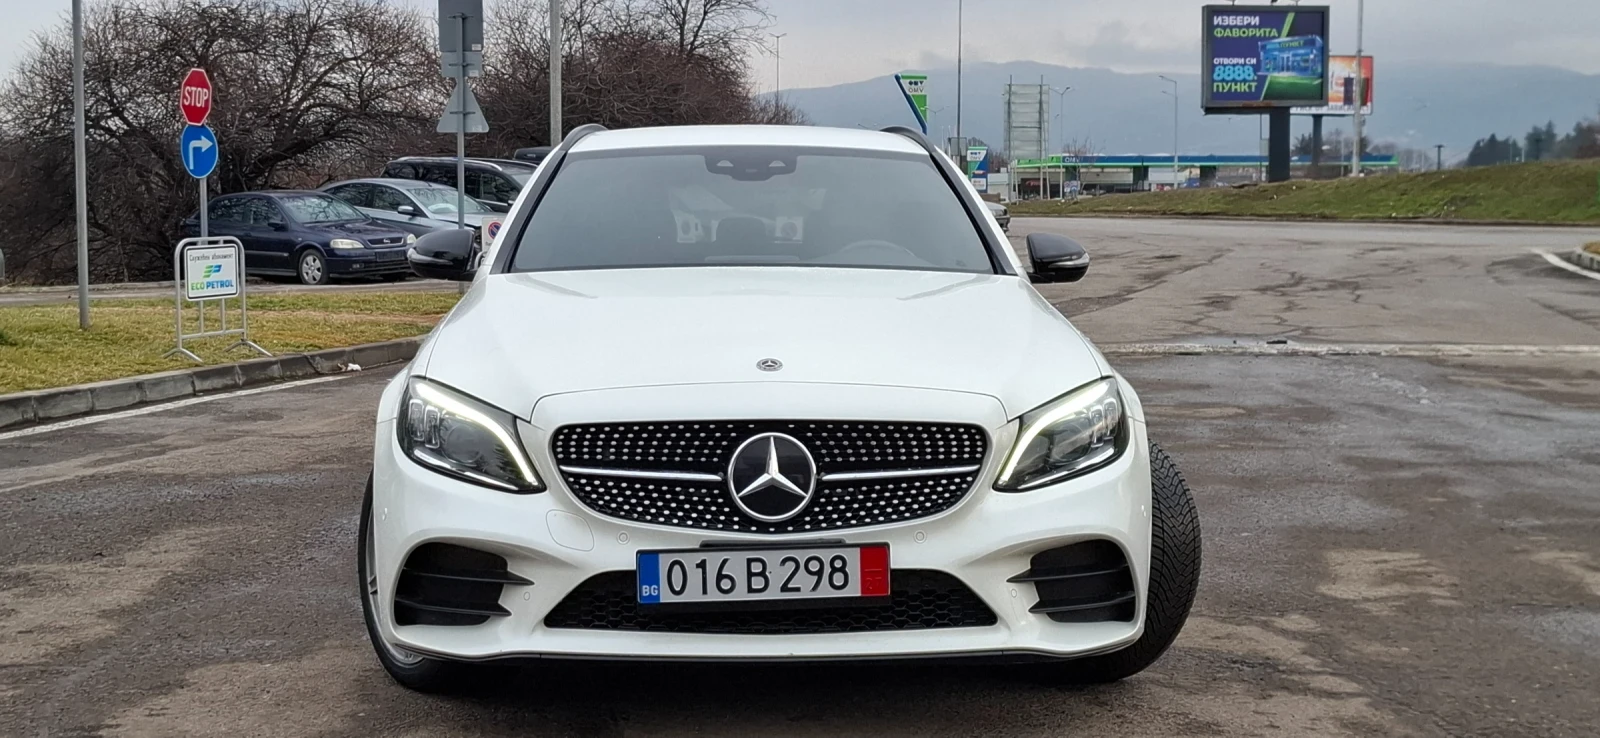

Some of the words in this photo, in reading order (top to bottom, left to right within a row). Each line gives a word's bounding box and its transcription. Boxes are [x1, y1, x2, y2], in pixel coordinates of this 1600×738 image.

[1213, 15, 1260, 26] ИЗБЕРИ
[1213, 27, 1279, 38] ФАВОРИТА
[1213, 57, 1245, 65] ОТВОРИ
[1246, 57, 1257, 65] СИ
[1213, 65, 1257, 81] 8888.
[1213, 82, 1258, 93] ПУНКТ
[183, 86, 209, 108] STOP
[190, 281, 205, 291] ECO
[206, 279, 234, 289] PETROL
[641, 585, 658, 597] BG
